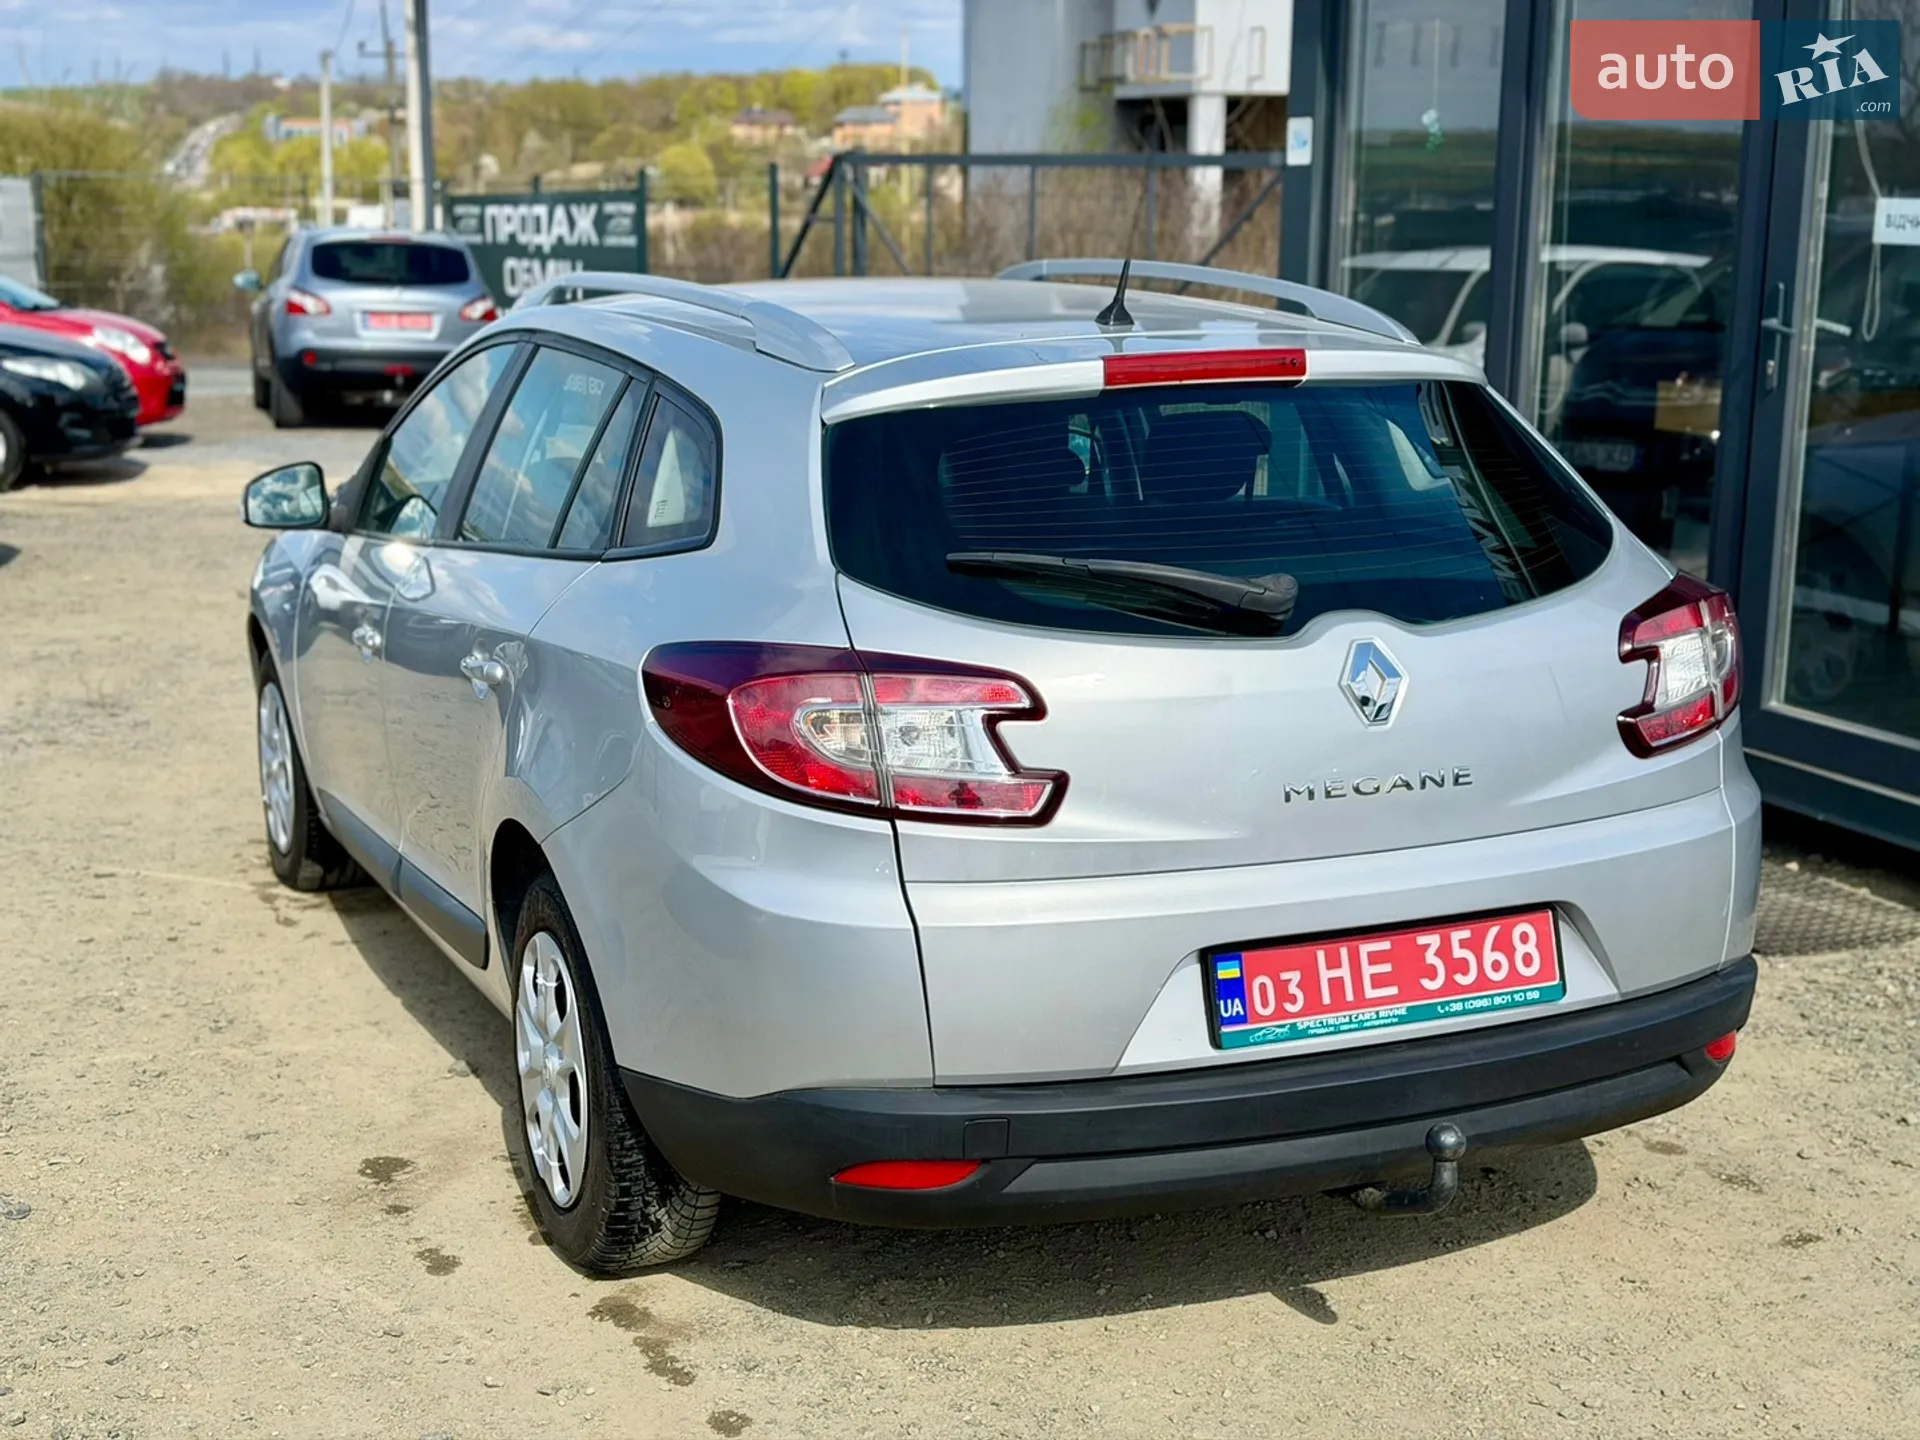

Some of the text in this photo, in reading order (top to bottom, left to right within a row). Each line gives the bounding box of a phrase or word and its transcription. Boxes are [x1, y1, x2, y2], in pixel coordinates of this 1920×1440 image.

[484, 202, 599, 253] ПРОДАЖ
[1282, 765, 1474, 804] MEGANE
[1251, 970, 1305, 1017] 03
[1316, 940, 1399, 1006] HE
[1415, 922, 1542, 992] 3568
[1219, 997, 1245, 1018] UA
[1445, 1001, 1463, 1012] +38
[1493, 995, 1511, 1006] 801
[1513, 992, 1525, 1002] 10
[1296, 1006, 1408, 1030] SPECTRUM CARS RIVNE
